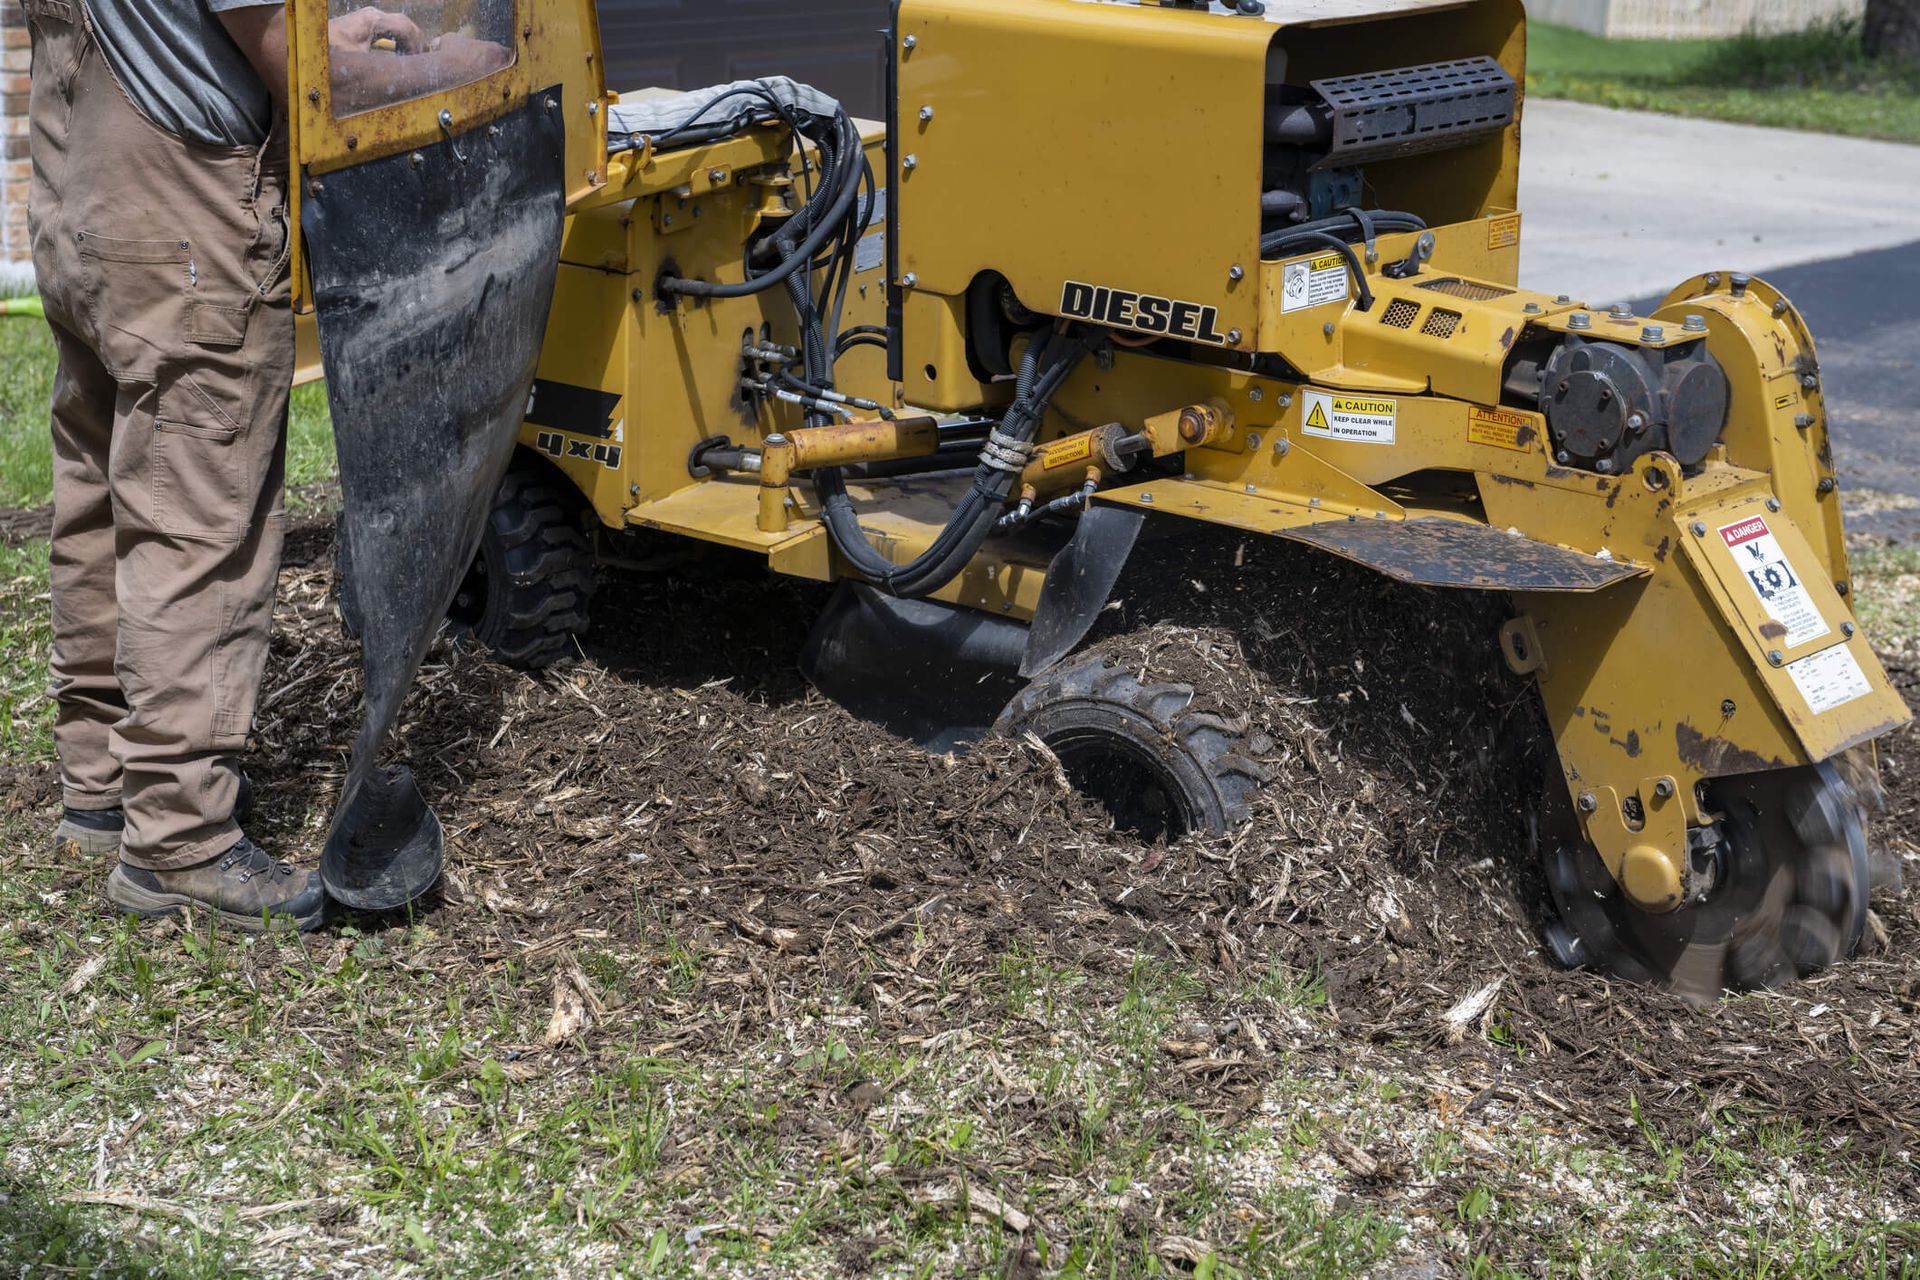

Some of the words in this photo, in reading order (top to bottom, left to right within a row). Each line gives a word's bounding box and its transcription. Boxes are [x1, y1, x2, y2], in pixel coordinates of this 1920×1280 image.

[1318, 255, 1347, 269] CAUTION
[1060, 280, 1225, 345] DIESEL
[1345, 401, 1393, 413] CAUTION
[1333, 415, 1350, 423] KEEP
[1351, 417, 1372, 425] CLEAR
[1372, 419, 1393, 427] WHILE
[1475, 409, 1526, 425] ATTENTION!
[1341, 428, 1377, 437] OPERATION
[1733, 521, 1765, 539] DANGER
